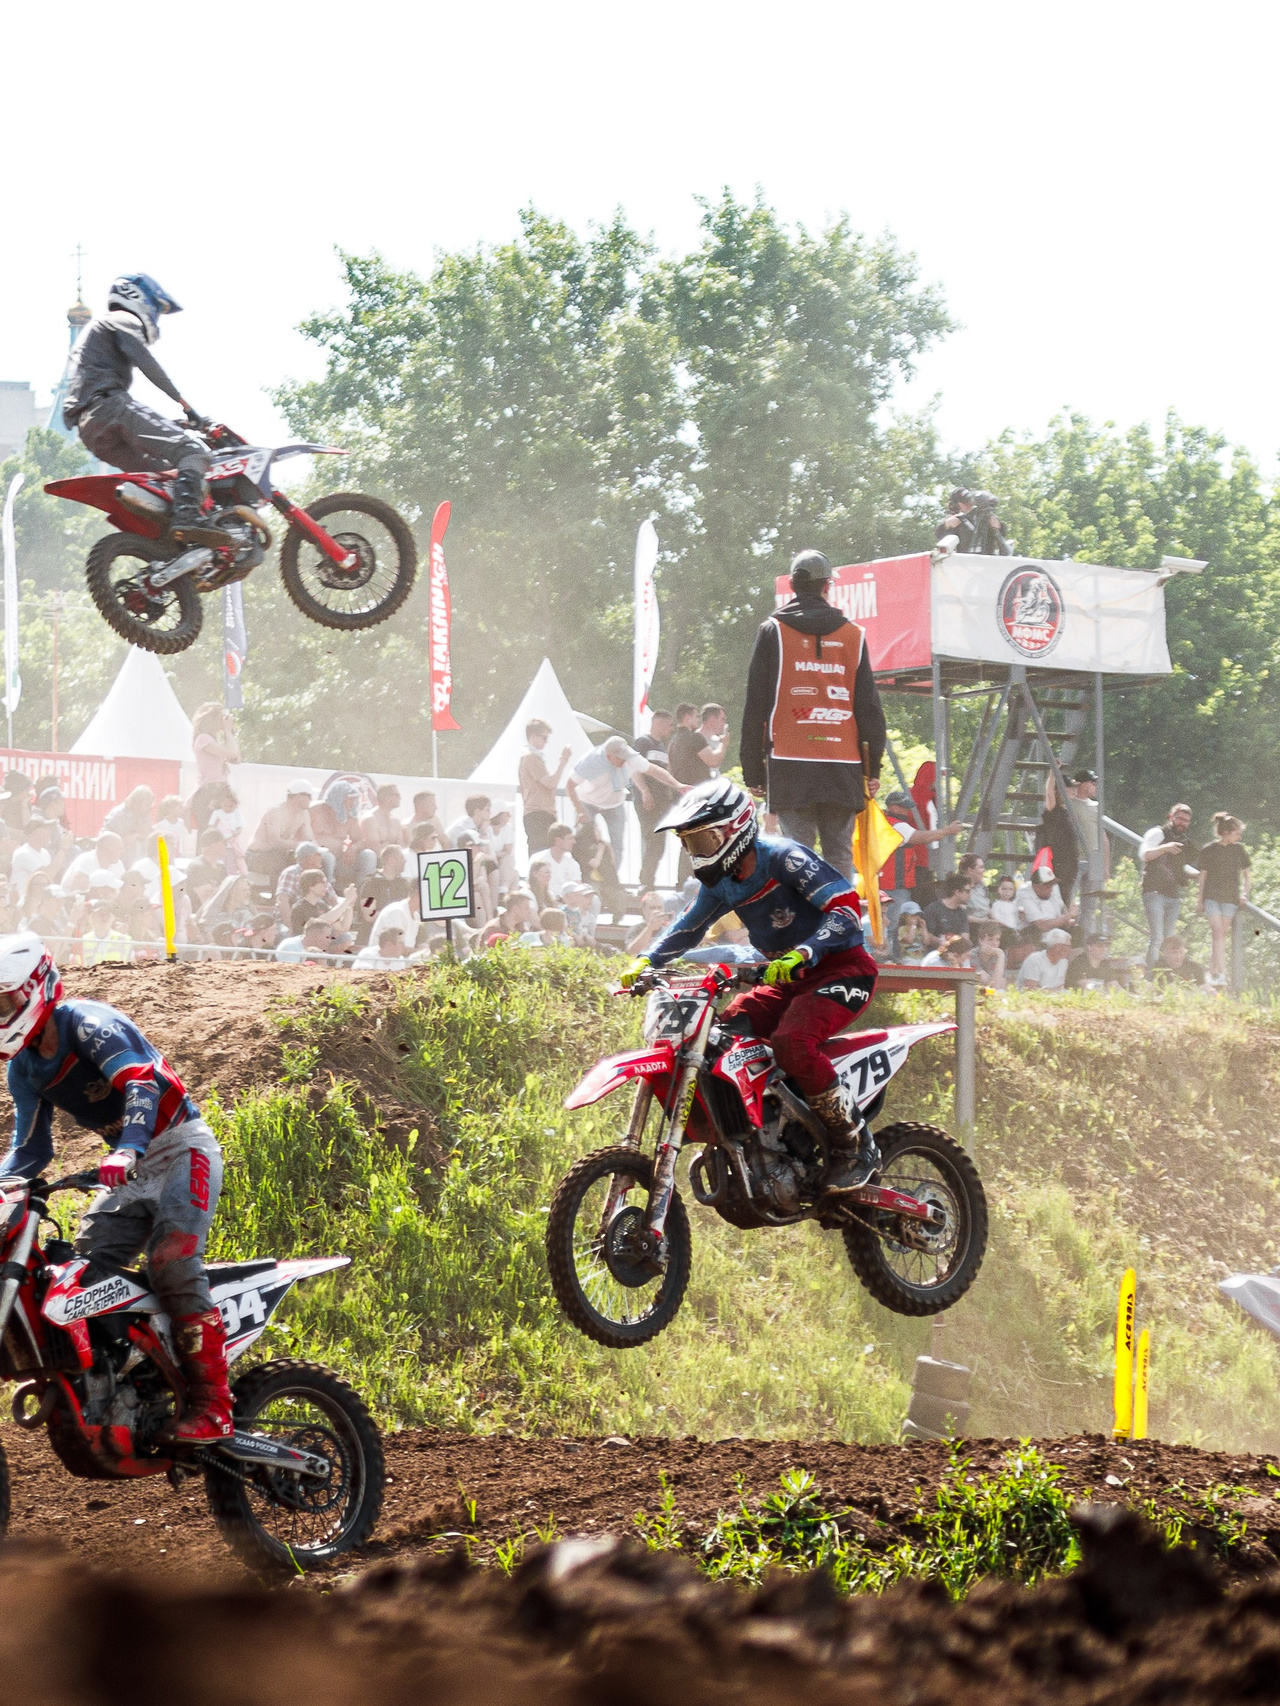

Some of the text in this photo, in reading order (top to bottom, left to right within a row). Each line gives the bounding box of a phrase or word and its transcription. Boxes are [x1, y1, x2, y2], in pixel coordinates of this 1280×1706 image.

[423, 858, 468, 911] 12
[634, 1061, 668, 1074] ЛАДОГА
[849, 1049, 892, 1097] 79
[64, 1279, 123, 1315] СБОРНАЯ
